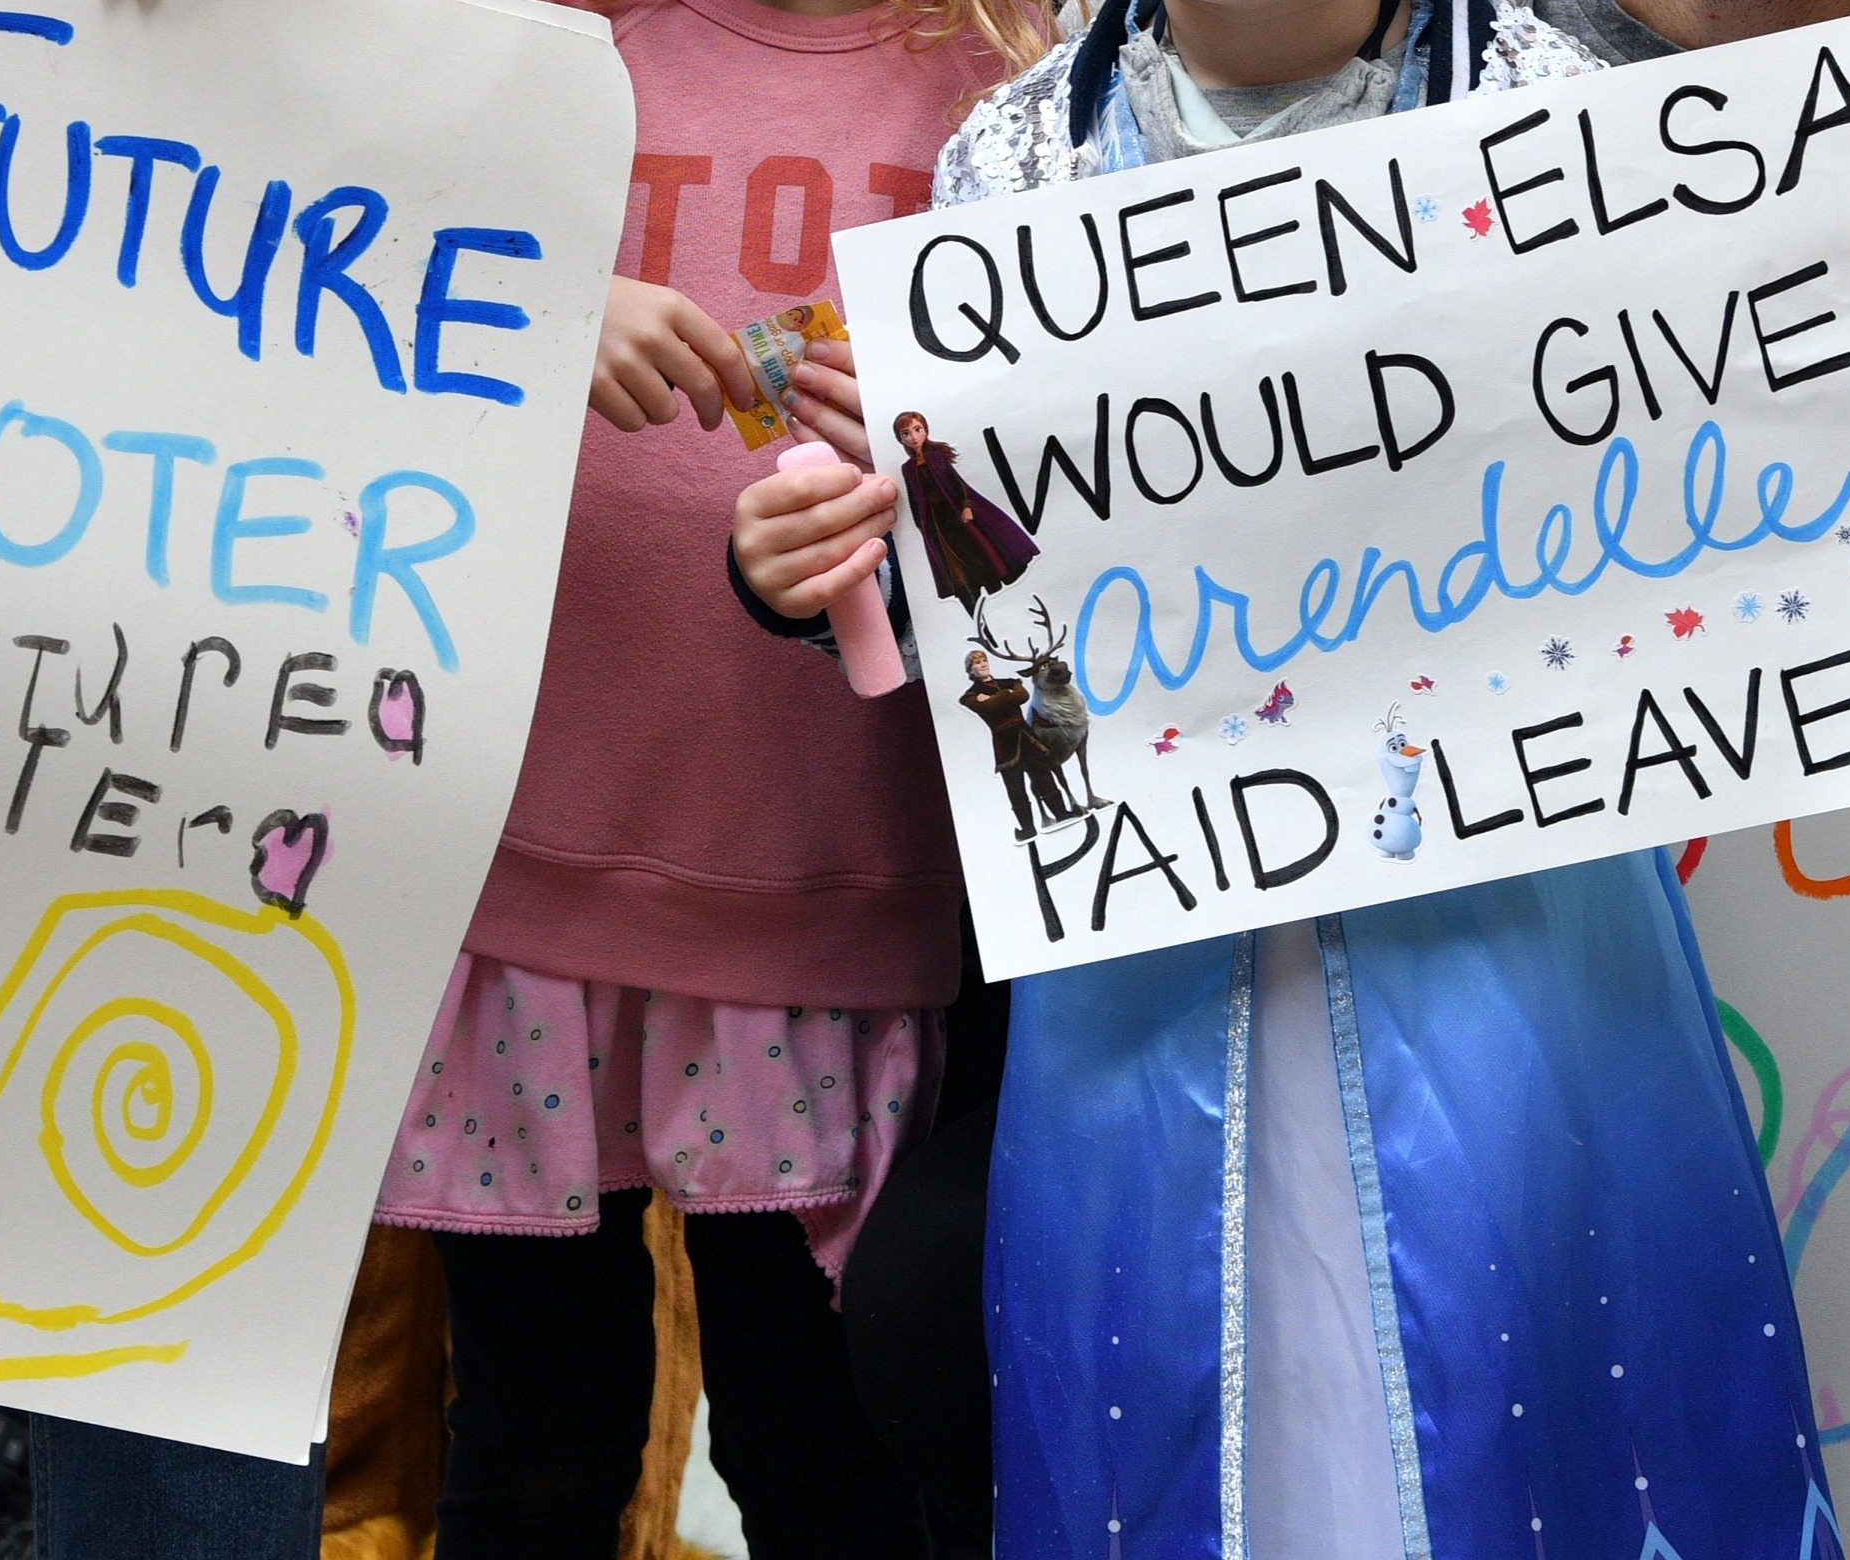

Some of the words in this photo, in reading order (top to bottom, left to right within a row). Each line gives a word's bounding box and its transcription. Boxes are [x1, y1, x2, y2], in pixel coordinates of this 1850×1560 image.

[908, 158, 1417, 365] QUEEN
[983, 349, 1455, 536] WOULD
[1026, 766, 1340, 941] PAID
